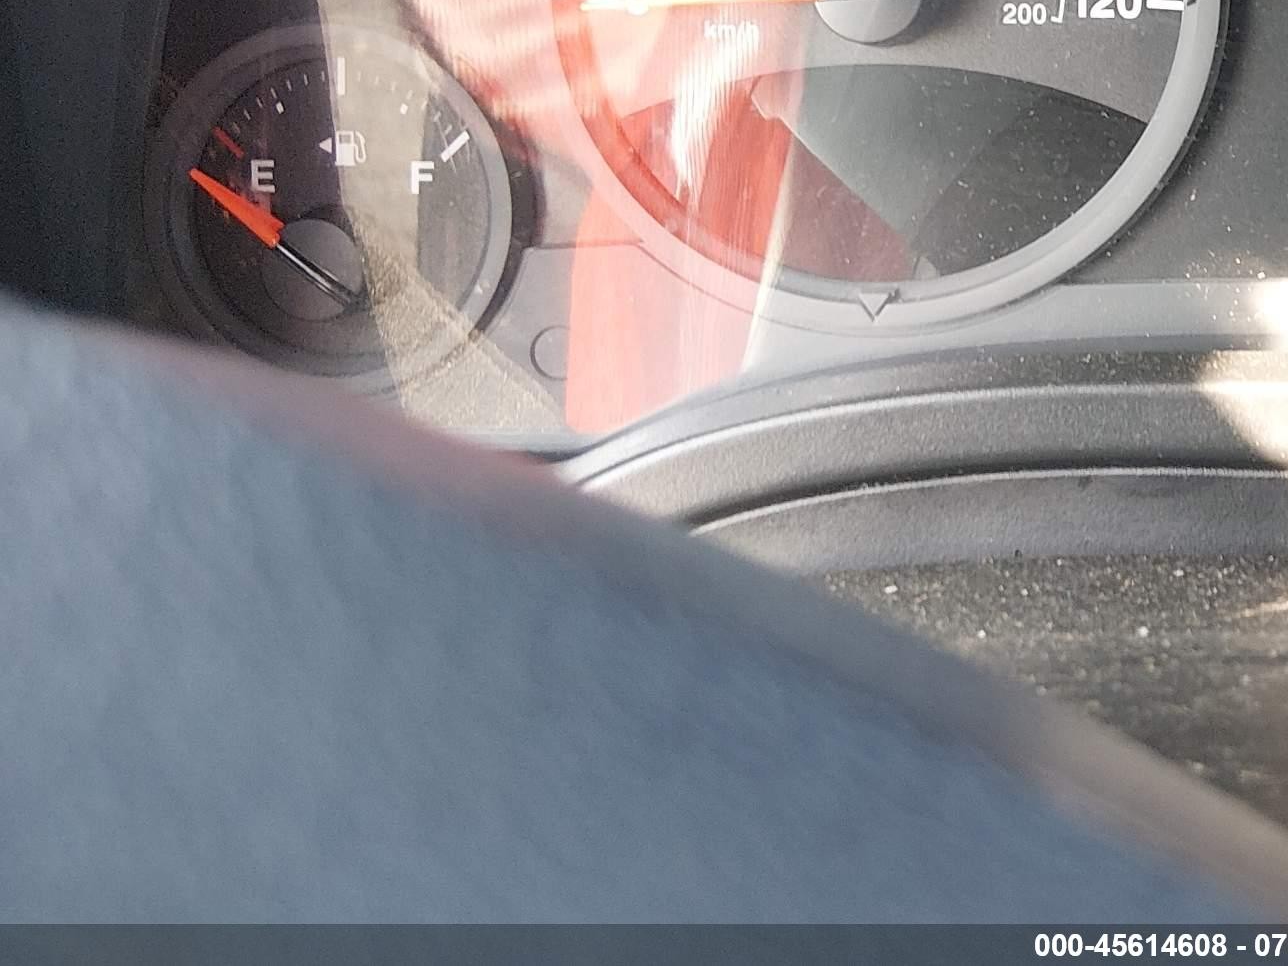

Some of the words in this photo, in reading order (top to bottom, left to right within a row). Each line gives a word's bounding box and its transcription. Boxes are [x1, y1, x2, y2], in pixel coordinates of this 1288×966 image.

[1002, 3, 1047, 26] 200
[250, 159, 276, 193] E
[410, 161, 435, 195] F
